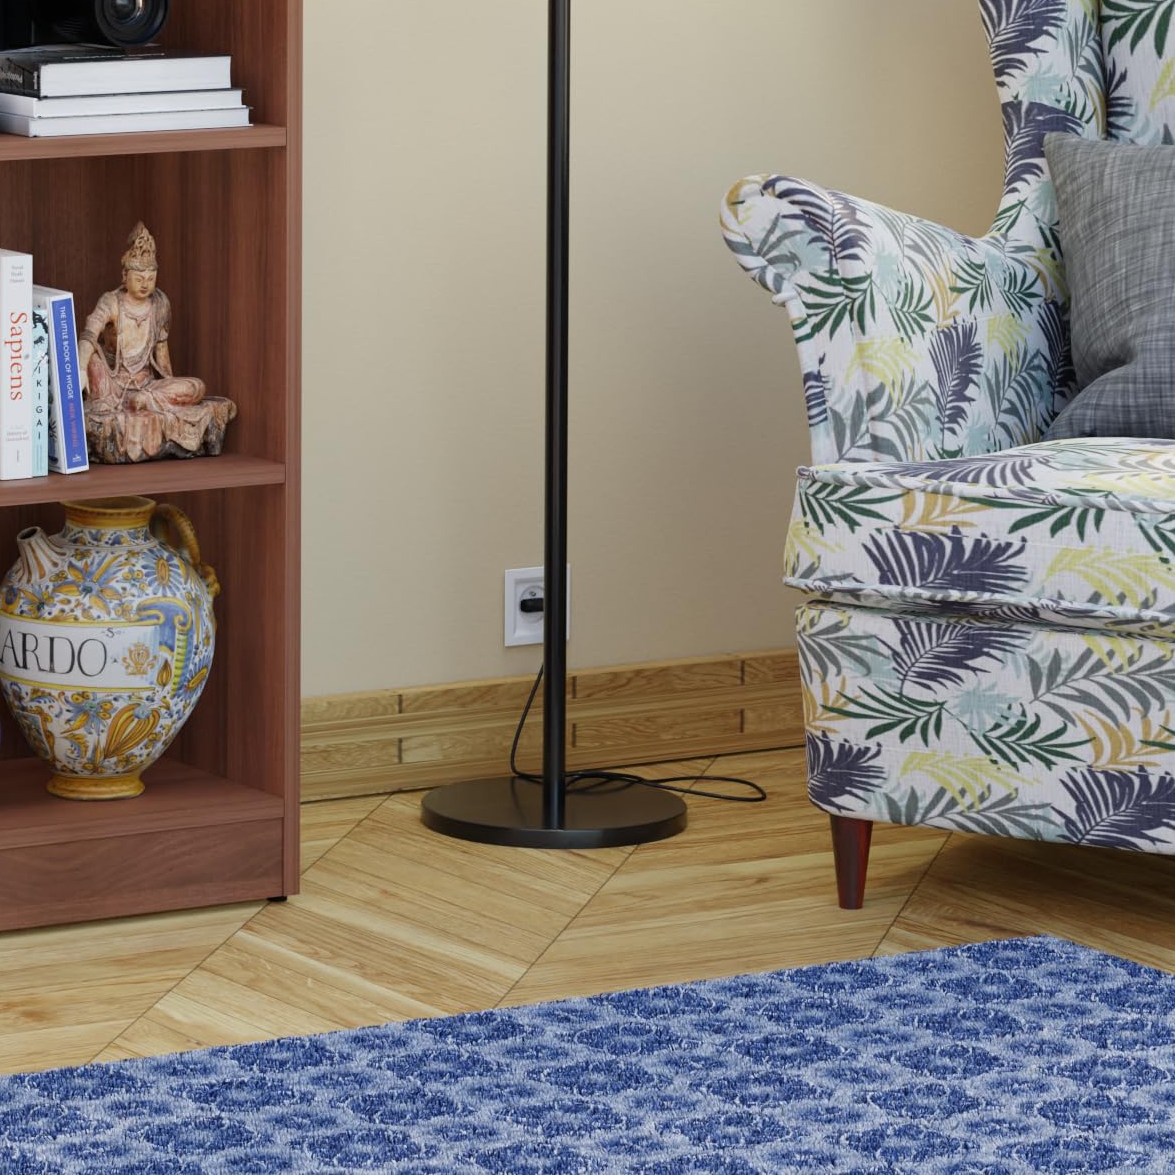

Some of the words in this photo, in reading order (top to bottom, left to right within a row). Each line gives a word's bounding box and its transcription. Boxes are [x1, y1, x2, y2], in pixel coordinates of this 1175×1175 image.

[60, 320, 69, 339] LITTLE
[4, 312, 28, 401] Sapiens
[62, 340, 71, 362] BOOK
[65, 362, 72, 373] OF
[66, 374, 74, 400] HYGGE
